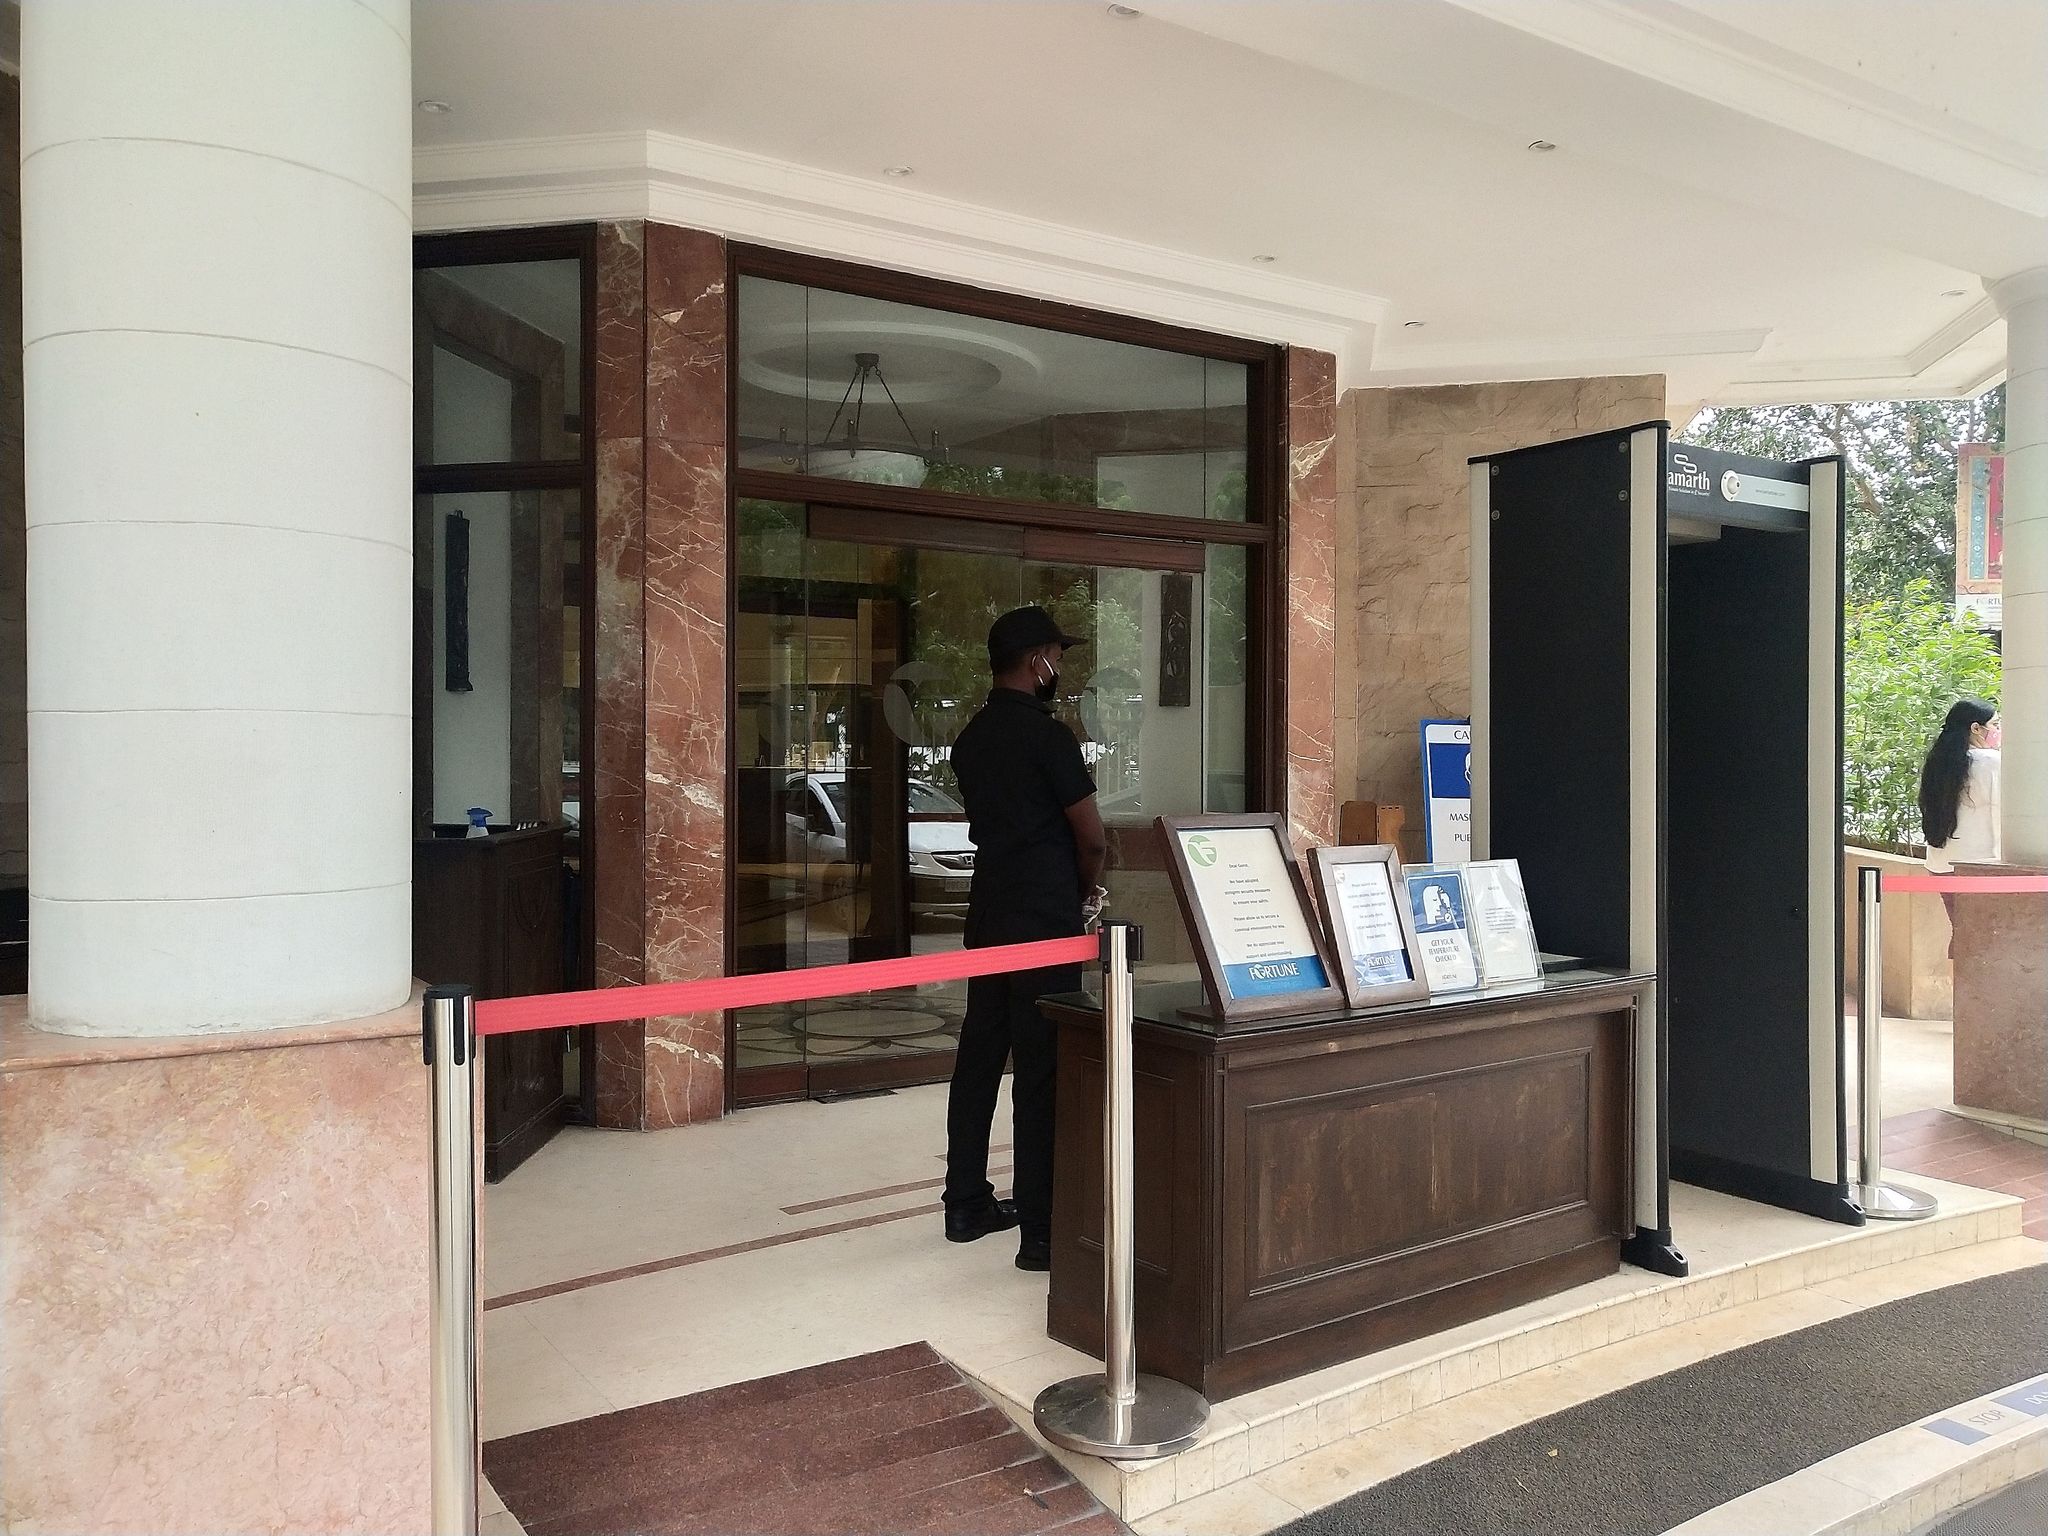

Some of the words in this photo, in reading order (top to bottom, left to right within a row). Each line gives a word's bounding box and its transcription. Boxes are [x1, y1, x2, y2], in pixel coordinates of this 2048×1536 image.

[1668, 471, 1710, 490] amarth
[1454, 730, 1471, 740] CA
[1431, 939, 1440, 947] GET
[1440, 938, 1455, 946] YOUR
[1428, 945, 1460, 955] TEMPERATURE
[1249, 962, 1300, 980] FORTUNE
[1968, 1410, 2006, 1426] STOP
